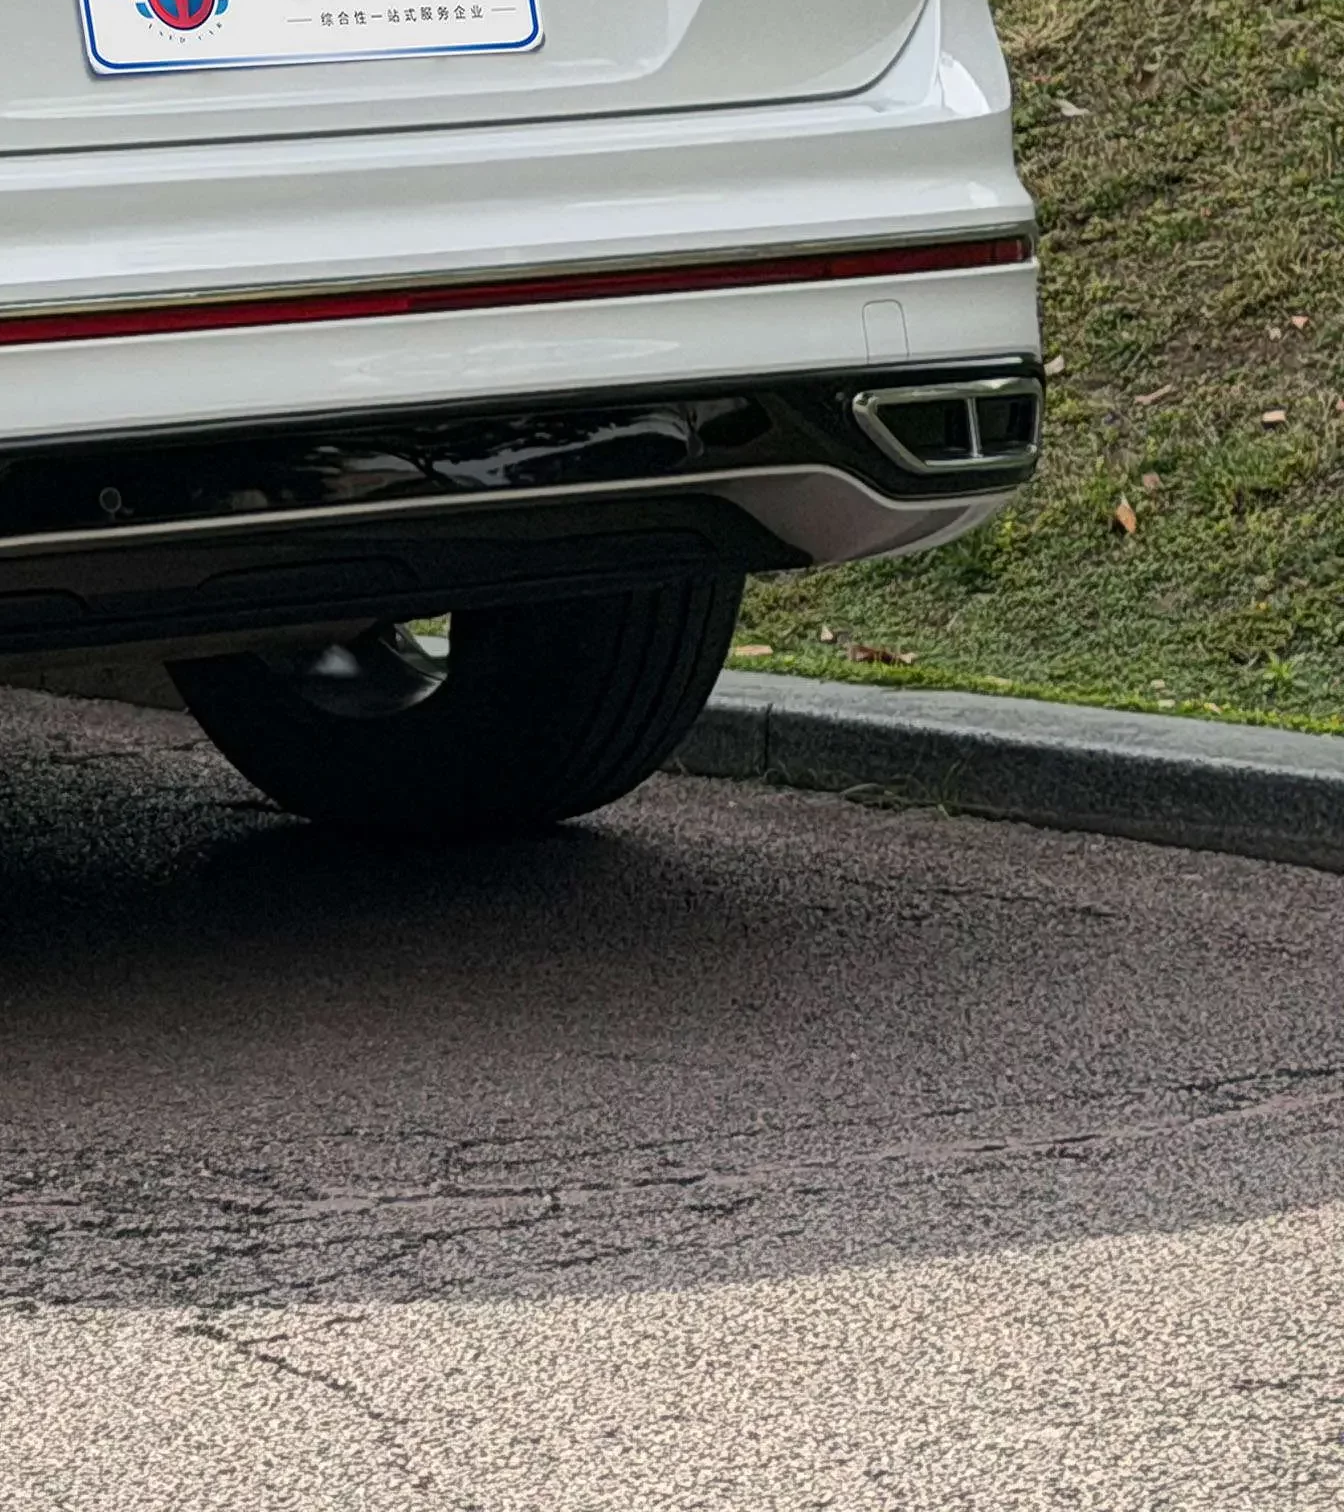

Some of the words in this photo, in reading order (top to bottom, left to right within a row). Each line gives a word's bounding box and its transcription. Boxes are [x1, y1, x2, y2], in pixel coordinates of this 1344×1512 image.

[320, 5, 485, 27] 综合性一站式服务企业
